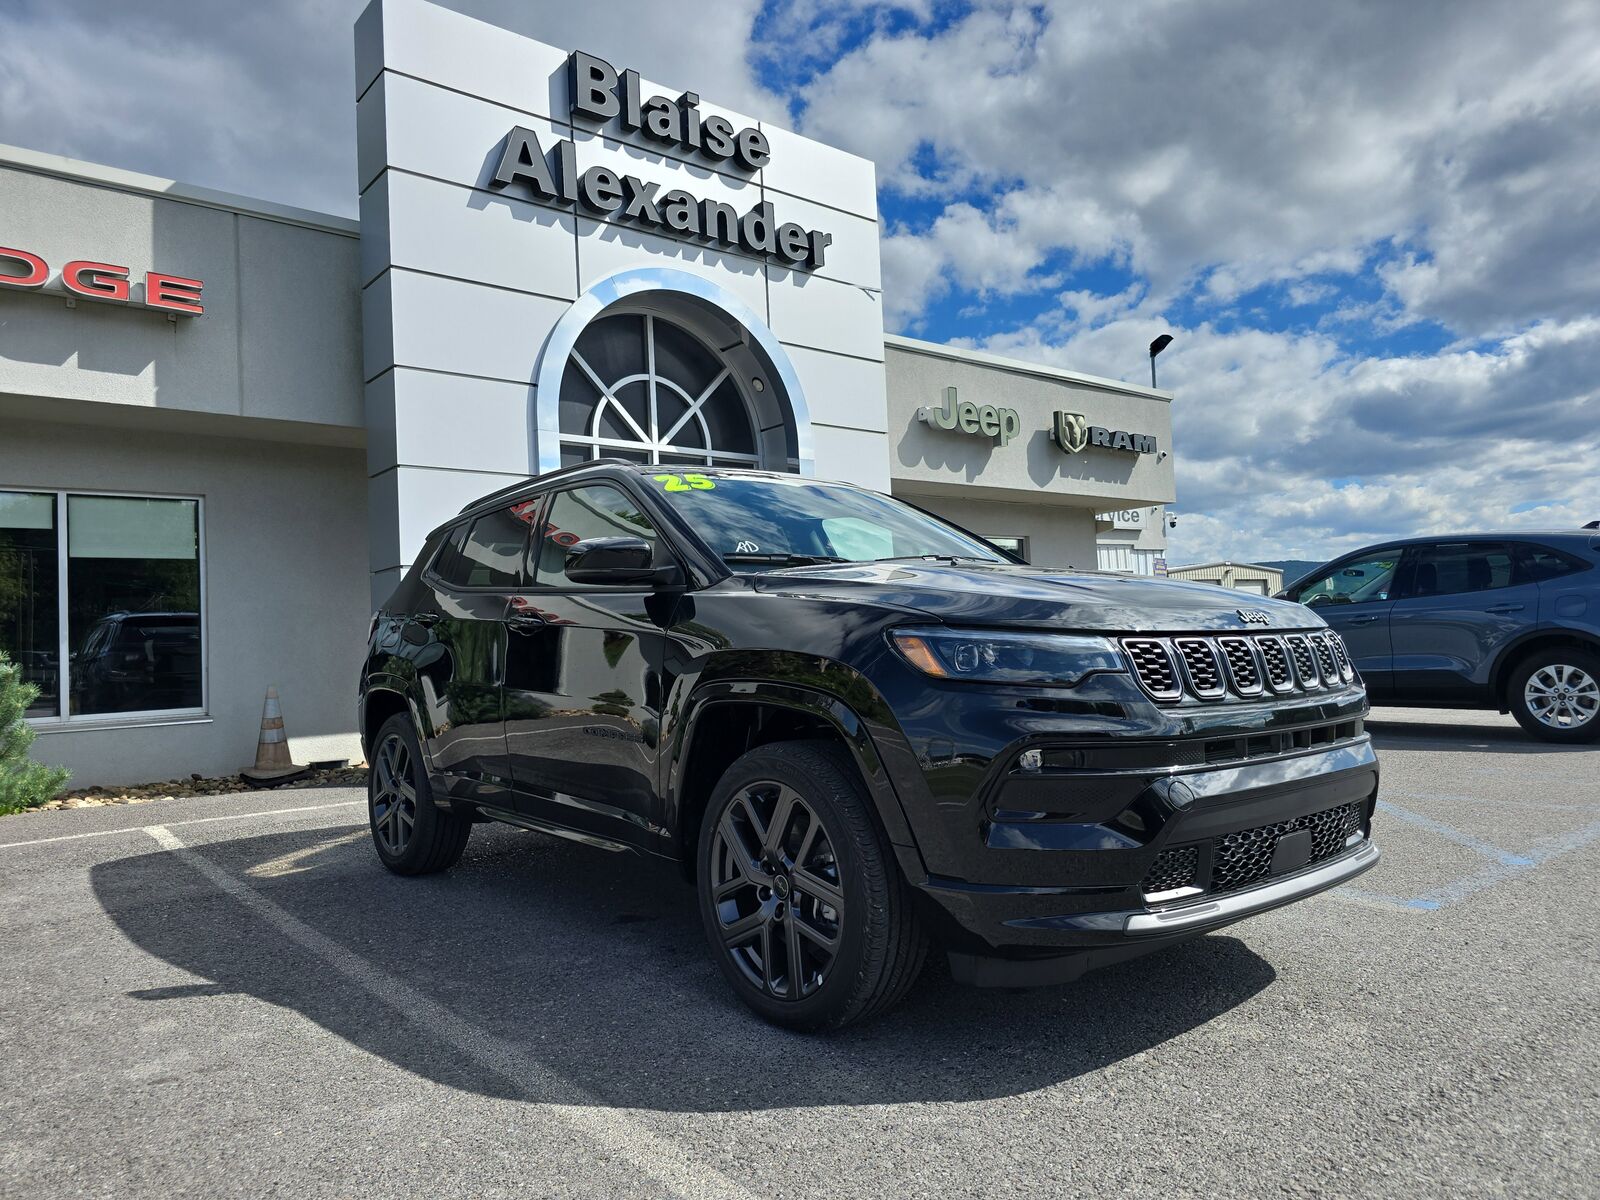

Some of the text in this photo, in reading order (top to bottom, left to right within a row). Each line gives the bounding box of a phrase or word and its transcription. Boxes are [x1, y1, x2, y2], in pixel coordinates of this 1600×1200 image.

[572, 50, 770, 172] Blaise
[489, 125, 832, 270] Alexander
[930, 387, 1020, 447] Jeep
[1090, 426, 1157, 454] RAM
[653, 474, 716, 492] 25
[1236, 609, 1270, 626] Jeep
